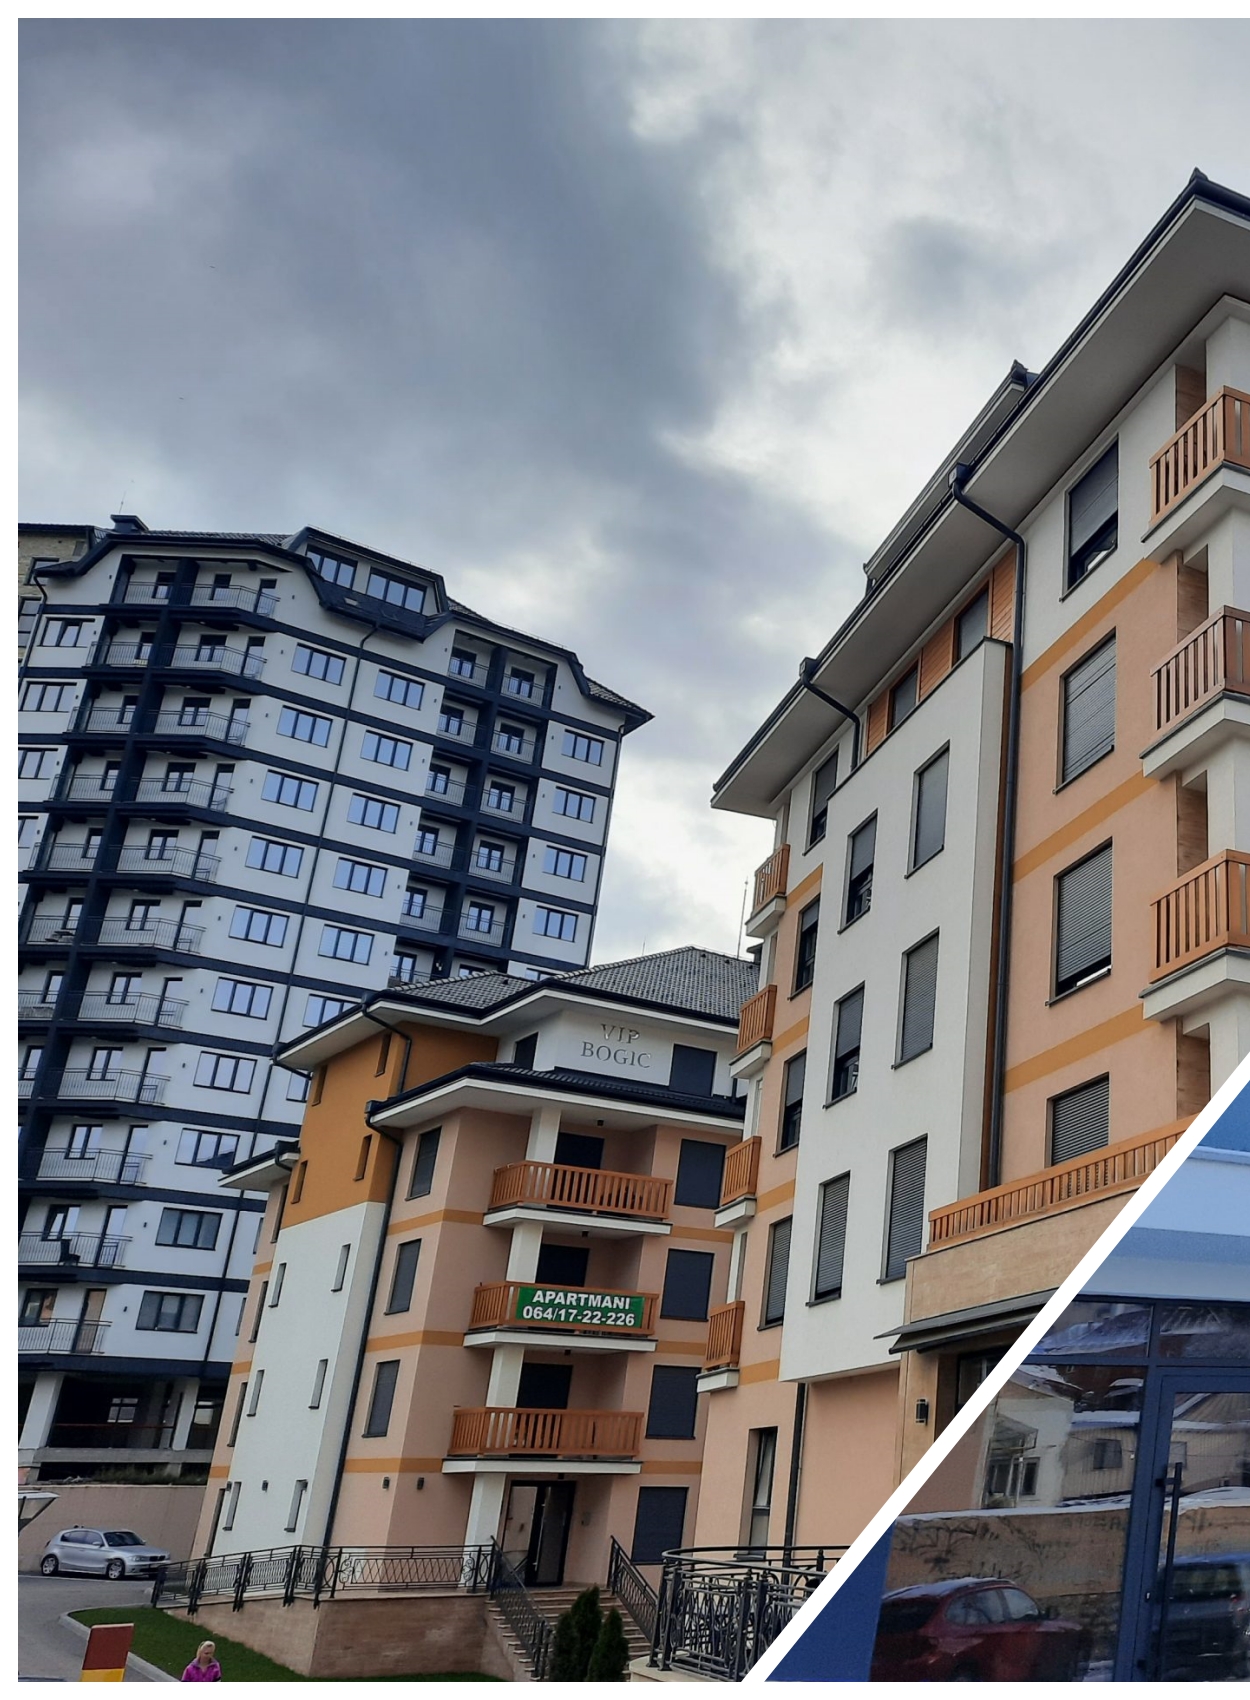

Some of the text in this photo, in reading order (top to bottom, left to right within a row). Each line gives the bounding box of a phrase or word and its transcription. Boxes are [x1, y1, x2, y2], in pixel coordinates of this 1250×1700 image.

[601, 1023, 640, 1044] VIP
[580, 1040, 651, 1068] BOGIC
[532, 1290, 631, 1310] APARTMANI
[522, 1305, 635, 1327] 064/17-22-226
